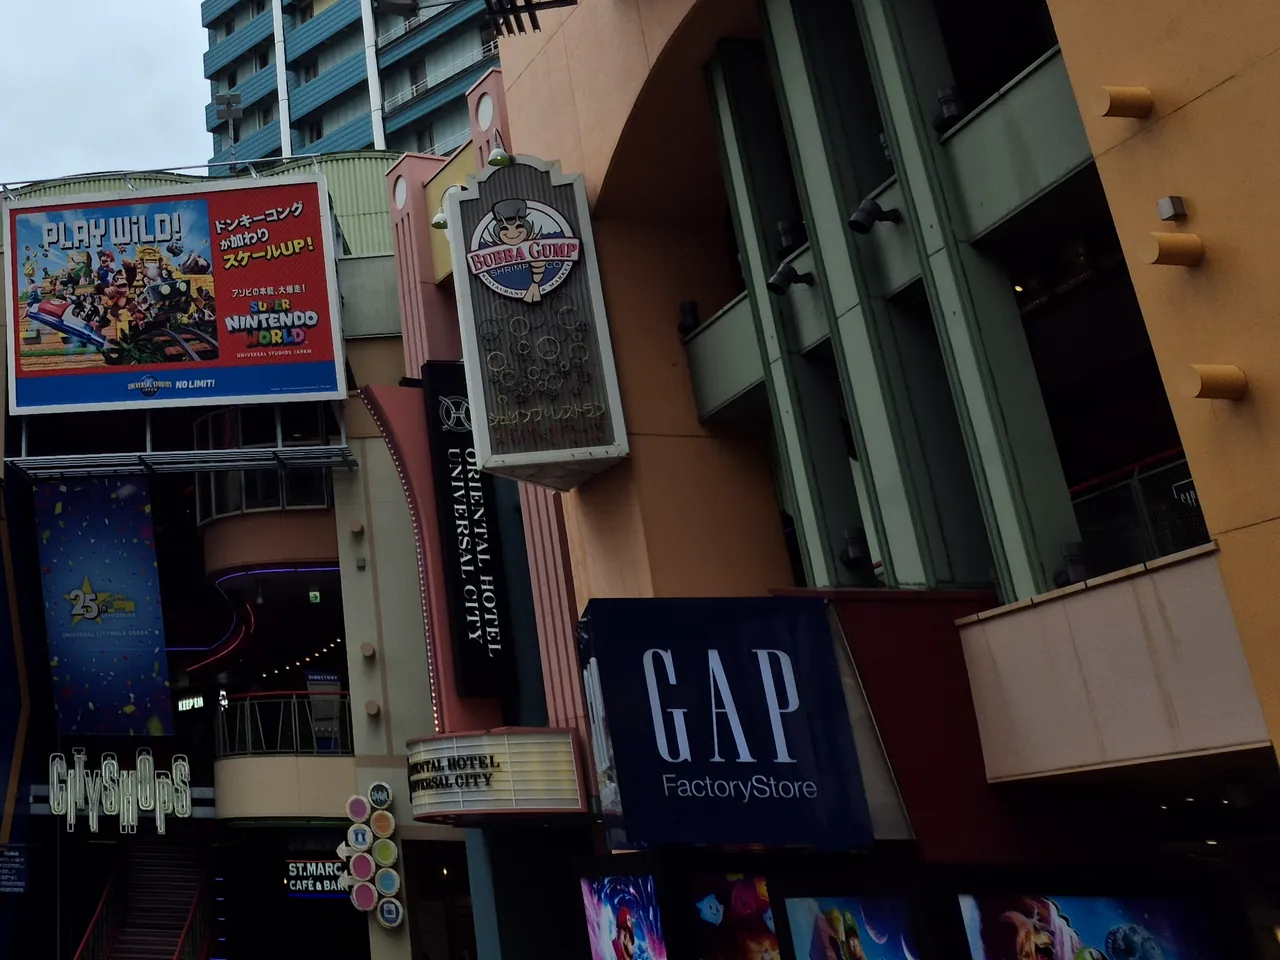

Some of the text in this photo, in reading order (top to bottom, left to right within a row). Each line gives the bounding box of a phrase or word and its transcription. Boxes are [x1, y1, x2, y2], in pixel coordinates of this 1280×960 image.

[214, 200, 304, 234] ドンキーコング
[43, 218, 107, 251] PLAY
[220, 228, 269, 251] が加わり
[470, 241, 578, 272] BUBBA GUMP
[481, 273, 524, 297] RESTAURANT
[549, 263, 571, 288] MARKET
[489, 263, 529, 277] SHRIMP
[249, 298, 291, 313] SUPER
[224, 310, 319, 333] NINTENDO
[175, 380, 189, 389] NO
[189, 379, 216, 389] LIMIT!
[447, 448, 483, 644] UNIVERSAL CITY
[465, 447, 502, 658] ORIENTAL HOTEL
[643, 648, 800, 763] GAP
[447, 755, 500, 771] HOTEL
[454, 773, 493, 788] CITY
[662, 774, 818, 803] FactoryStore
[288, 862, 342, 876] ST.MARC
[289, 876, 314, 891] CAFÉ
